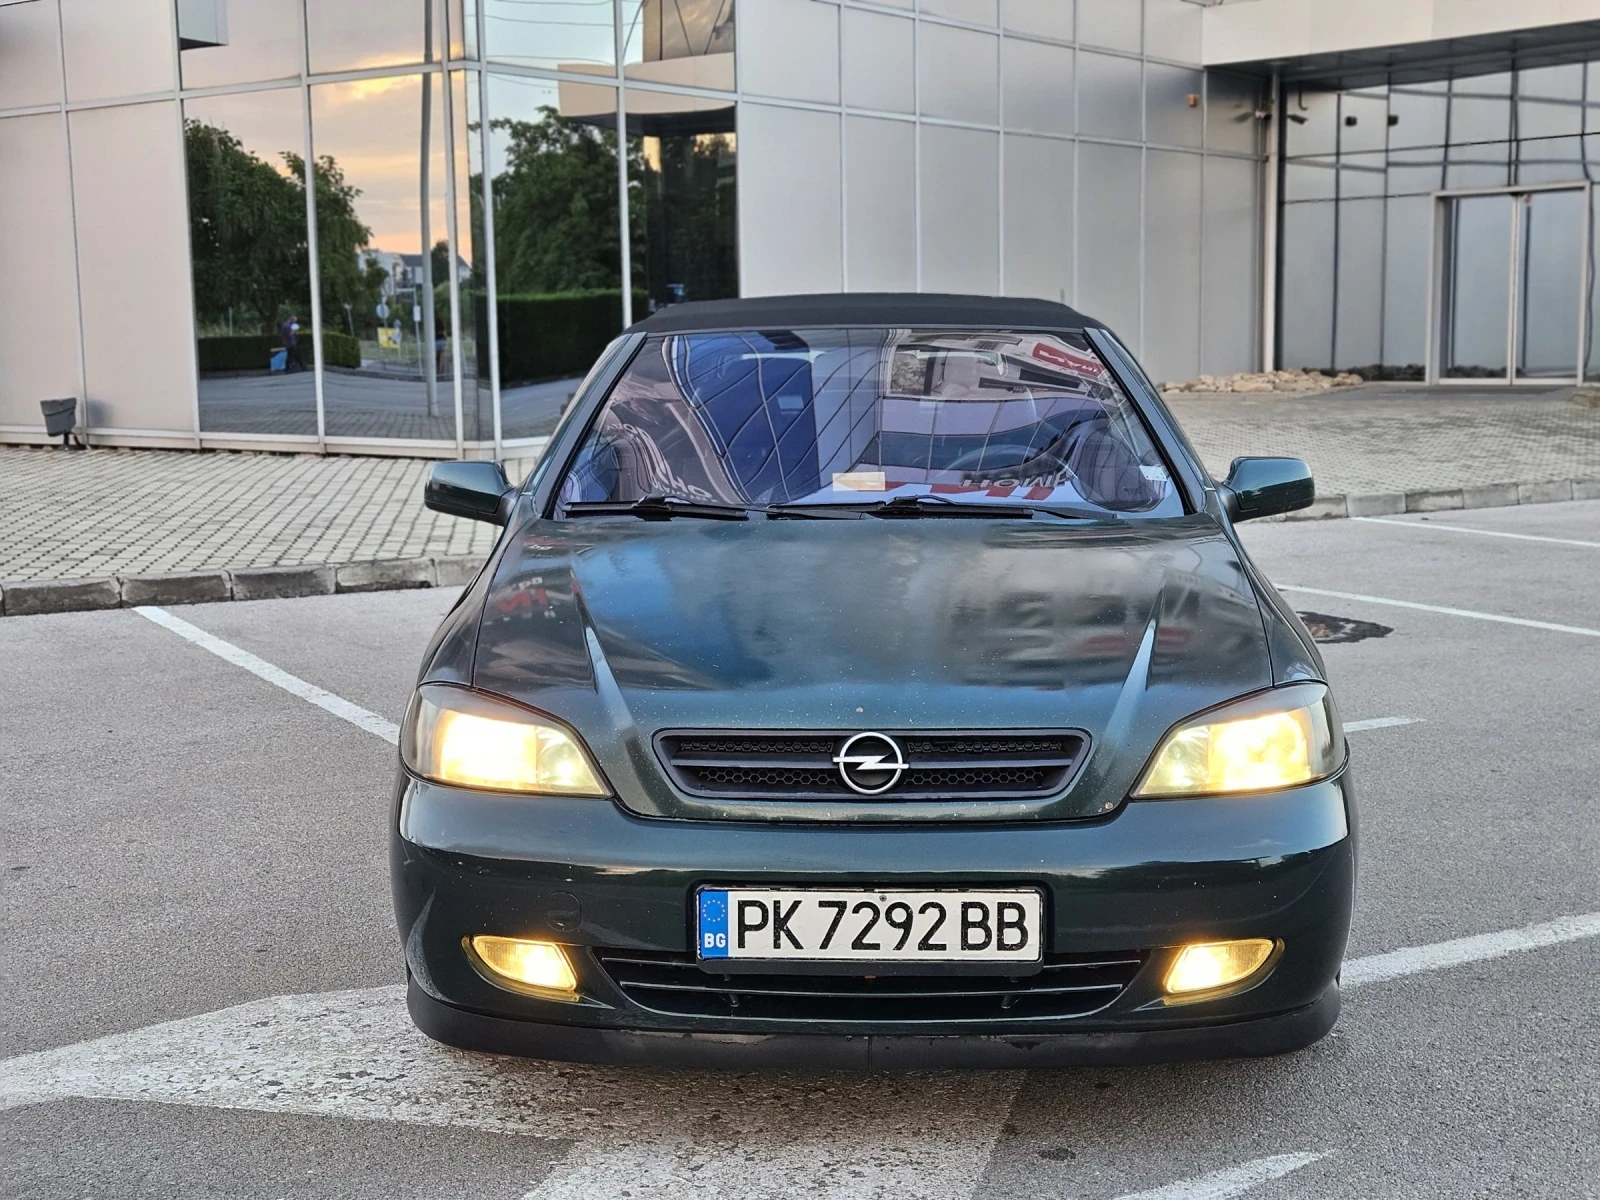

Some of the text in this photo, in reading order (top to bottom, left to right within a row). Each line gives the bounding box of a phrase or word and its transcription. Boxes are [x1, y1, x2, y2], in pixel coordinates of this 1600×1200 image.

[704, 932, 726, 948] BG
[737, 899, 1029, 952] PK 7292 BB
